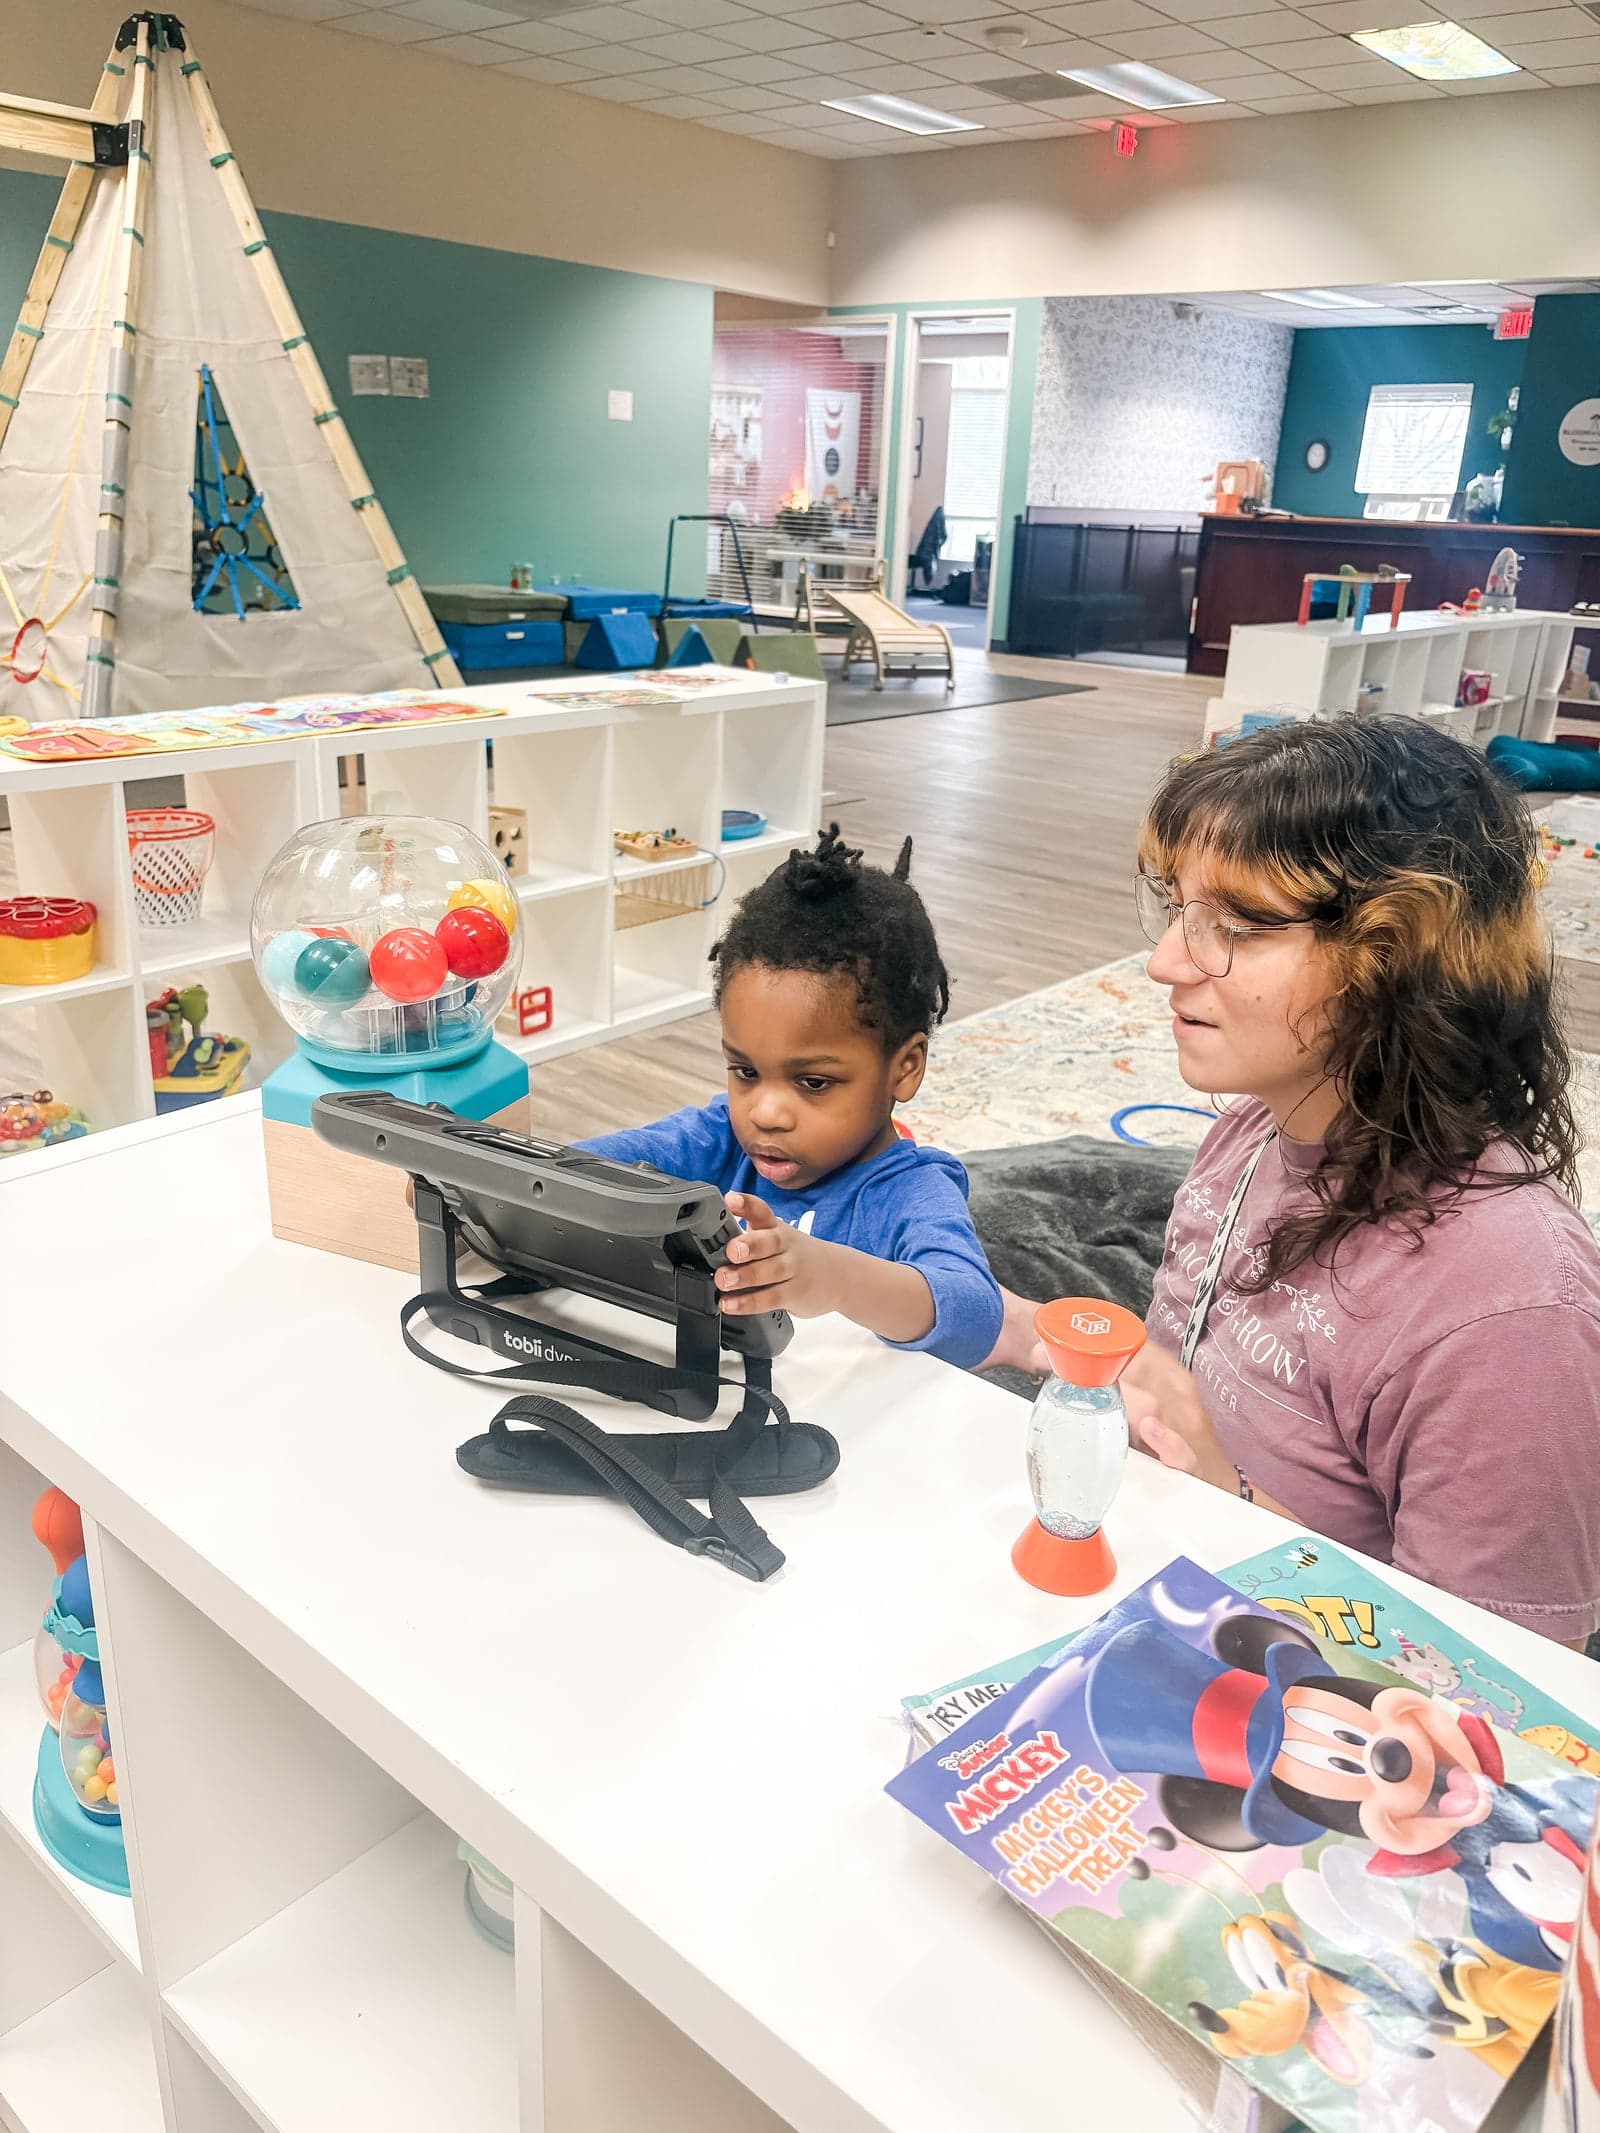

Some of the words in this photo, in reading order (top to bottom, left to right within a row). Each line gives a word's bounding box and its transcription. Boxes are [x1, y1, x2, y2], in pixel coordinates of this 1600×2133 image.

[503, 1330, 542, 1358] tobii
[1194, 1348, 1238, 1412] CENTER
[948, 1731, 1070, 1834] MICKEY
[1011, 1778, 1146, 1895] HALLOWEEN
[1066, 1819, 1148, 1893] TREAT
